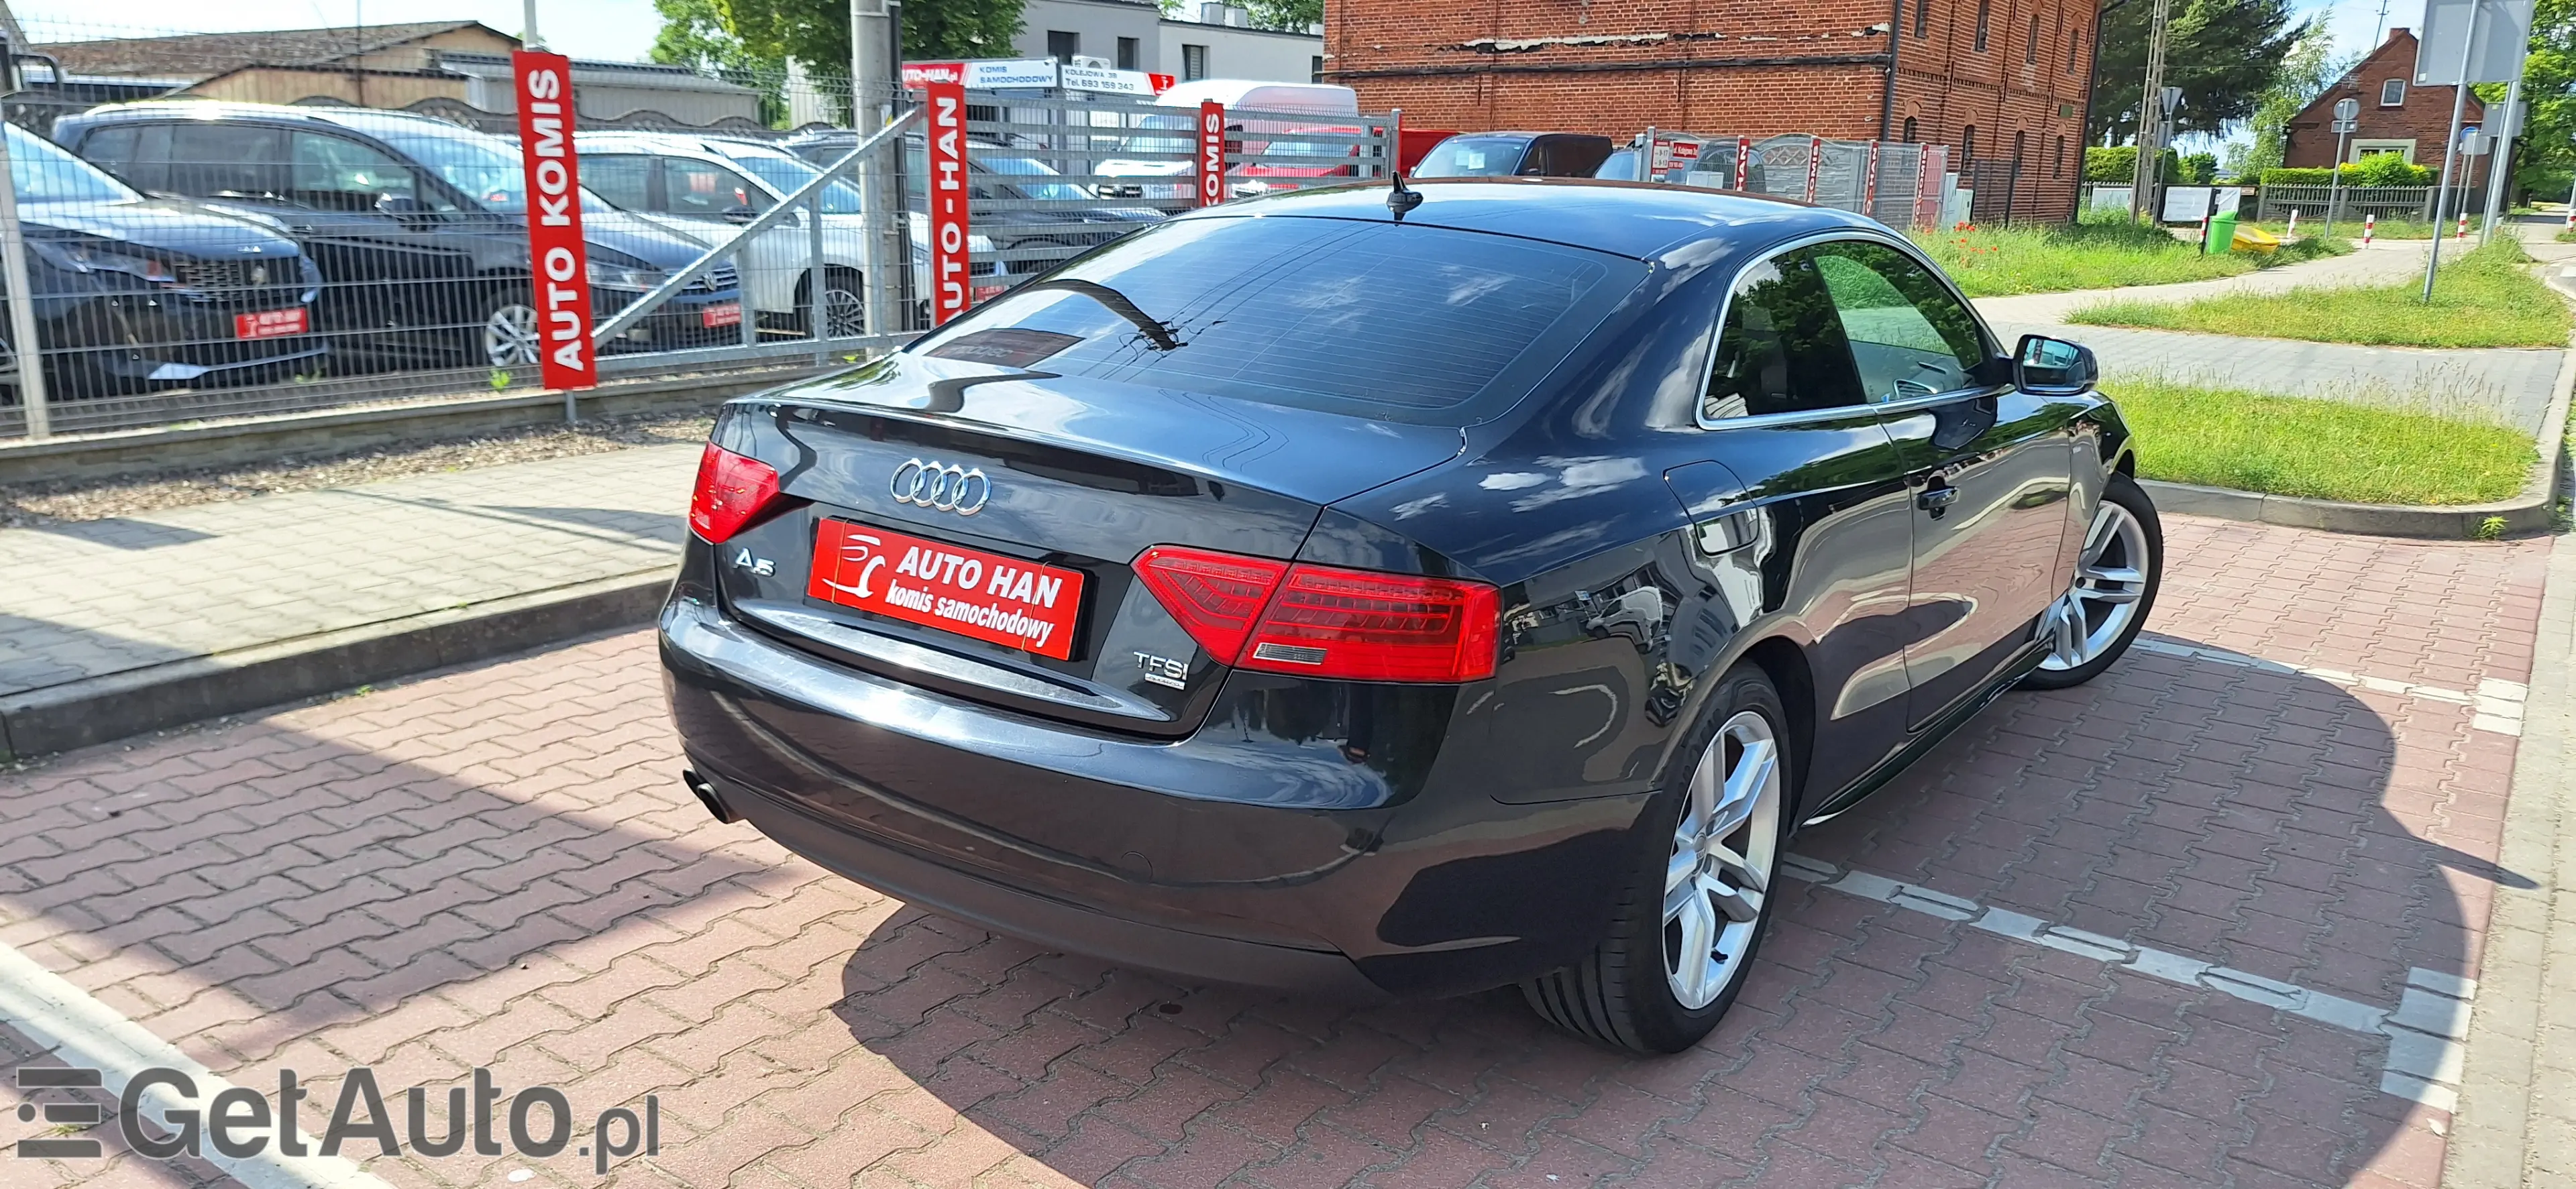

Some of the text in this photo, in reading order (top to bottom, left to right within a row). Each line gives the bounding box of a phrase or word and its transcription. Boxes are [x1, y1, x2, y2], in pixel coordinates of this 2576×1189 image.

[1065, 68, 1104, 78] KOLEJOWA
[1081, 80, 1099, 88] 693
[1102, 81, 1116, 90] 159
[1118, 82, 1134, 91] 343
[527, 68, 584, 372] AUTO KOMIS
[733, 547, 775, 577] A5
[896, 545, 1063, 609] AUTO HAN
[885, 578, 1055, 648] komis samochodowy
[1134, 650, 1189, 681] TFSI
